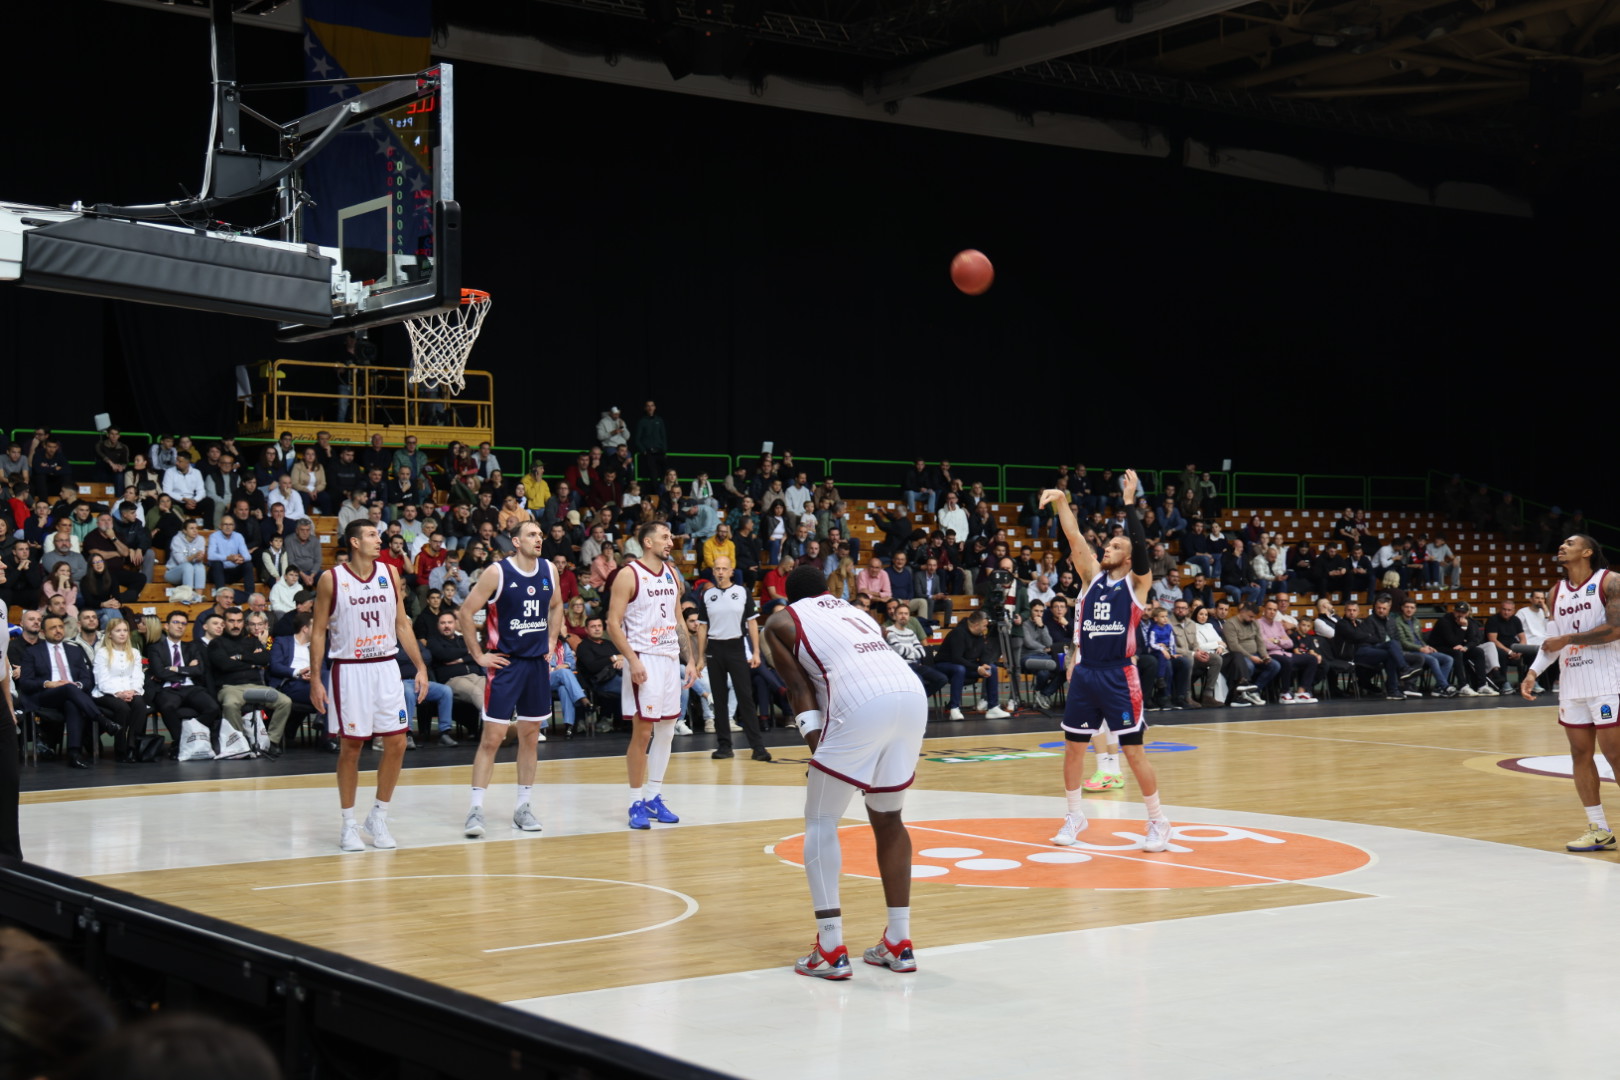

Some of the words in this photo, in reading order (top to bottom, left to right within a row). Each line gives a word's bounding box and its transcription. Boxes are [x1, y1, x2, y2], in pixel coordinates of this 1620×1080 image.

[647, 588, 675, 598] bosna
[349, 595, 387, 606] bosna
[523, 600, 540, 617] 34
[660, 603, 667, 618] 5
[1094, 602, 1111, 620] 22
[361, 611, 380, 628] 44
[355, 636, 372, 647] bh
[854, 641, 893, 654] SARA
